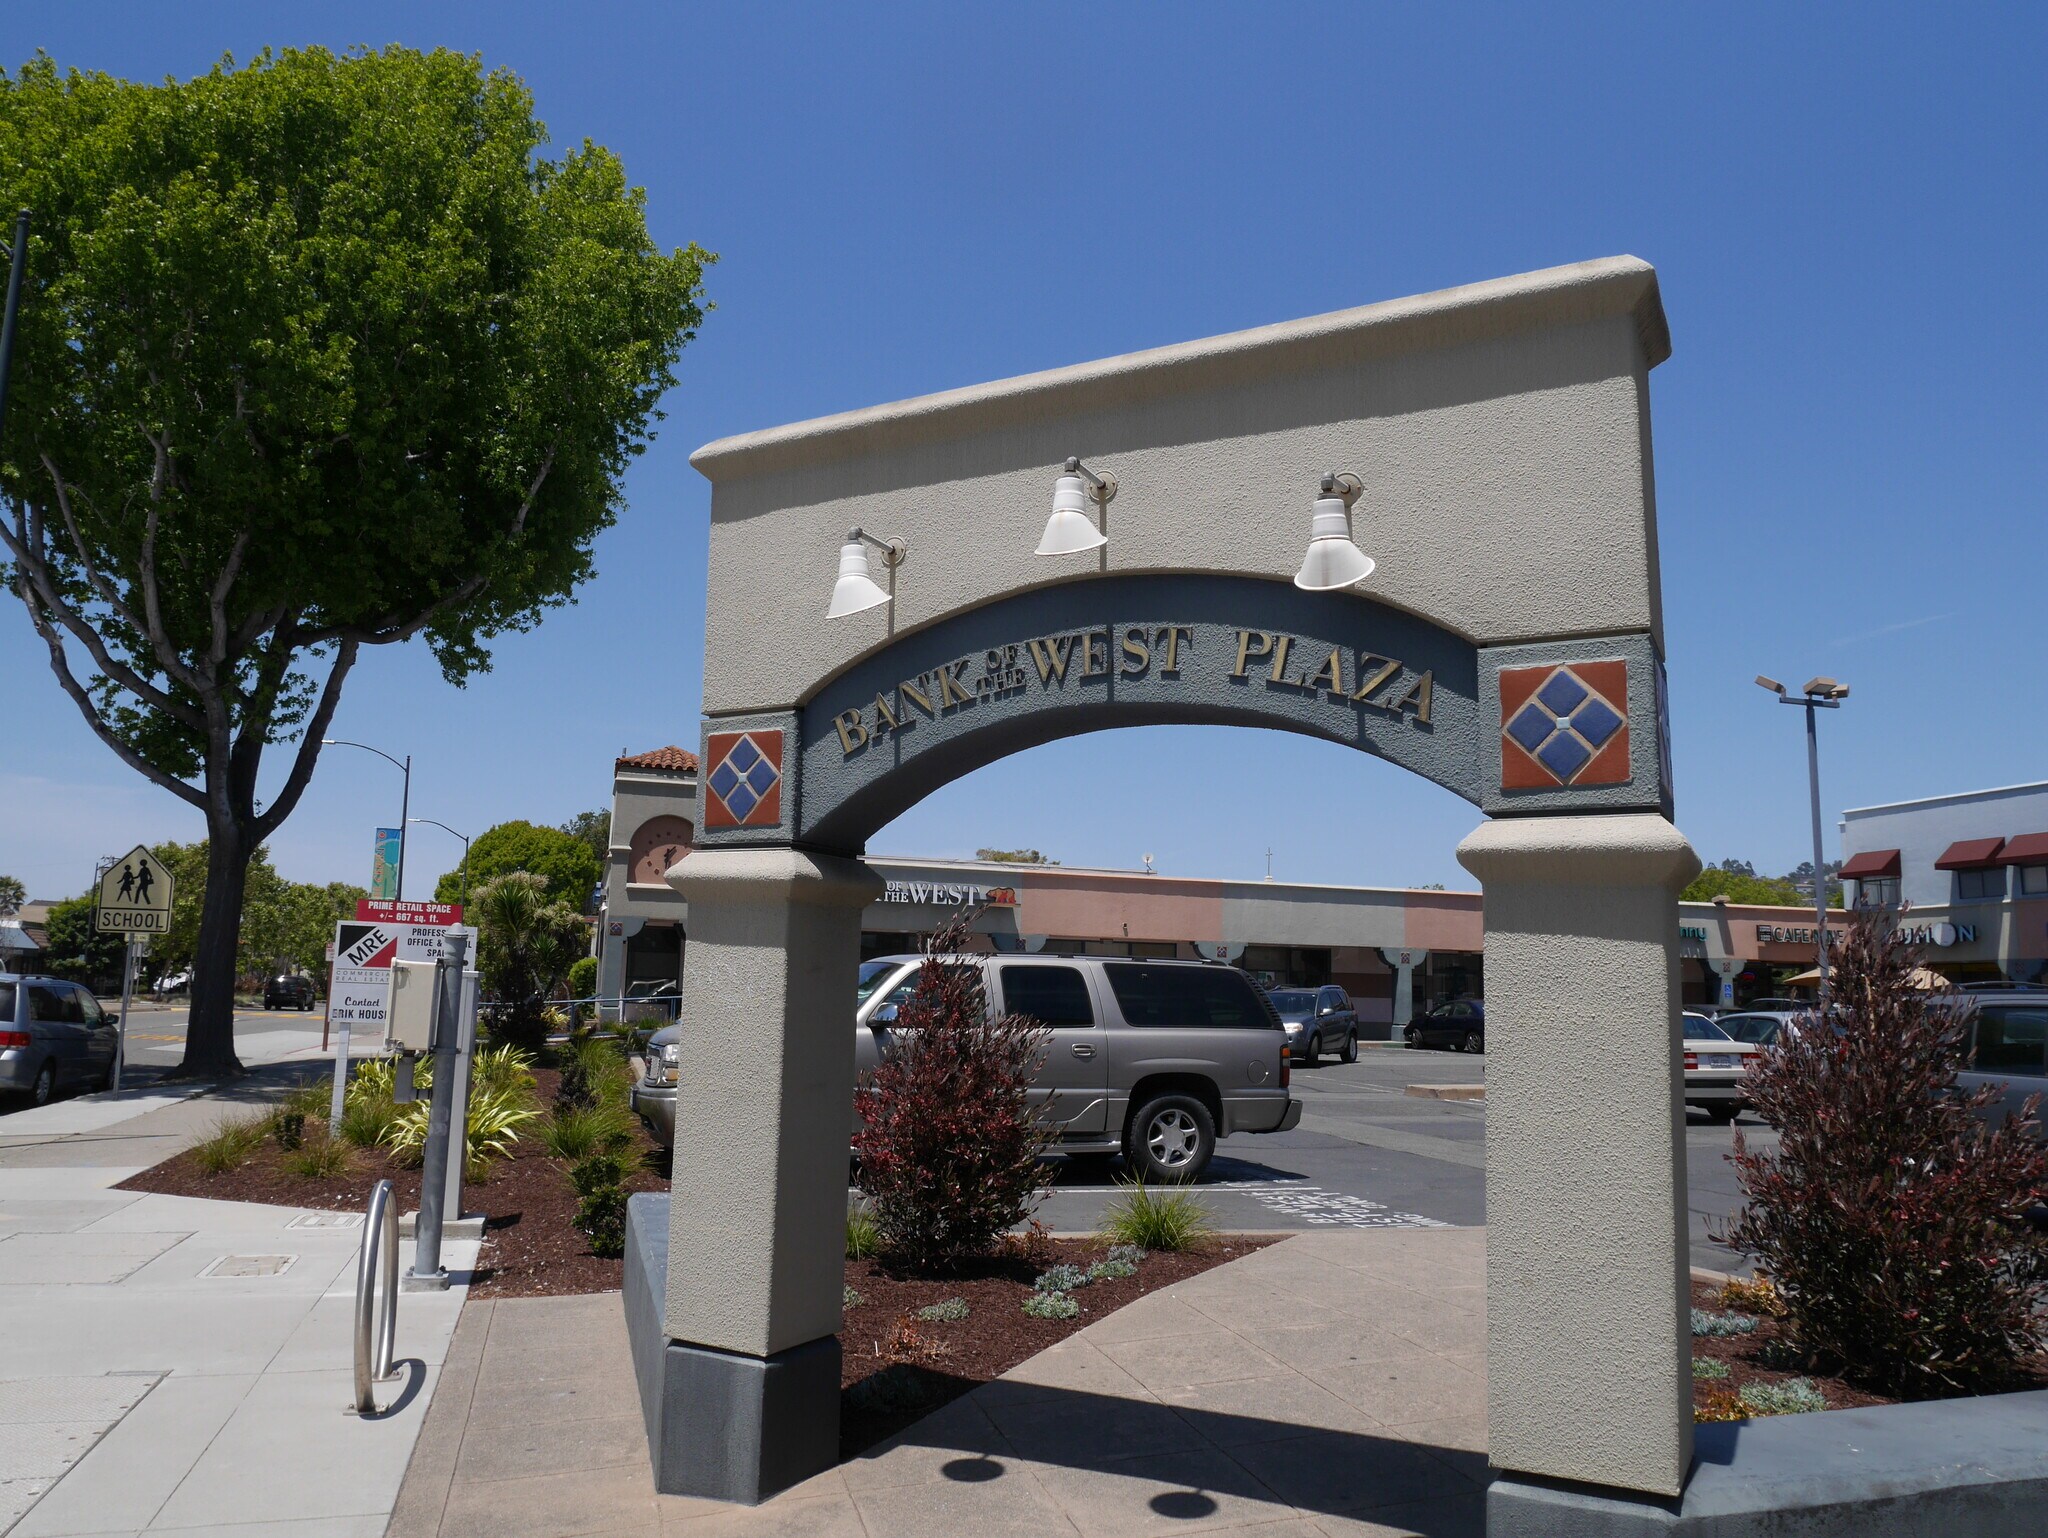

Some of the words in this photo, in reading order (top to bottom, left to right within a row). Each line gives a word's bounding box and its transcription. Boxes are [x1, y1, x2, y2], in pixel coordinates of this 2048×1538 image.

[985, 645, 1018, 669] OF
[1026, 626, 1193, 682] WEST
[976, 668, 1027, 696] THE
[1228, 630, 1433, 724] PLAZA
[831, 659, 977, 755] BANK
[883, 892, 909, 903] THE
[908, 882, 980, 906] WEST
[886, 881, 901, 892] OF
[368, 901, 393, 910] PRIME
[396, 903, 424, 912] RETAIL
[426, 904, 451, 914] SPACE
[102, 912, 164, 929] SCHOOL
[396, 913, 411, 921] 667
[414, 914, 426, 923] sq.
[429, 914, 439, 923] ft.
[412, 928, 447, 937] PROFESS
[1772, 927, 1810, 944] CAFE
[346, 929, 388, 966] MRE
[407, 938, 433, 947] OFFICE
[436, 938, 442, 947] &
[336, 970, 390, 978] COMMERCIA
[344, 996, 380, 1007] Contact
[332, 1009, 354, 1019] ERIK
